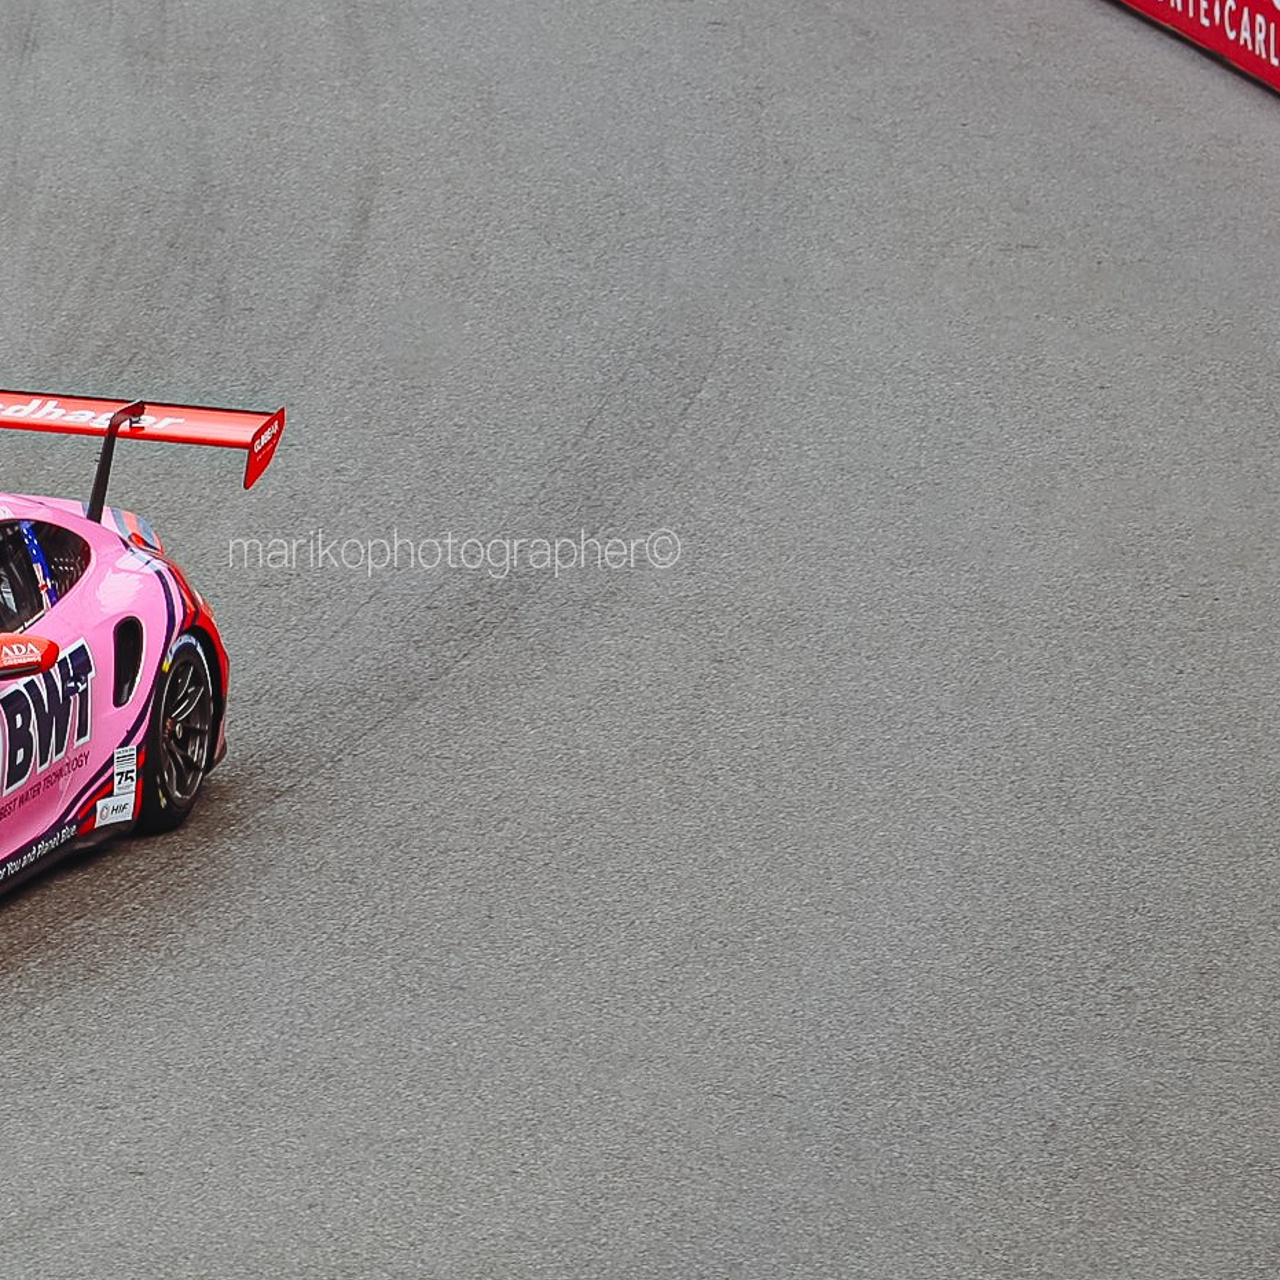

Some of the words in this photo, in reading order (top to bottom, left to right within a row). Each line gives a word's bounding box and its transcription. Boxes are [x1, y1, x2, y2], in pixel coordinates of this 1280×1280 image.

[1, 642, 40, 658] ADA
[115, 768, 136, 786] 75
[6, 858, 21, 878] You
[21, 845, 37, 868] and
[36, 831, 60, 859] Planet
